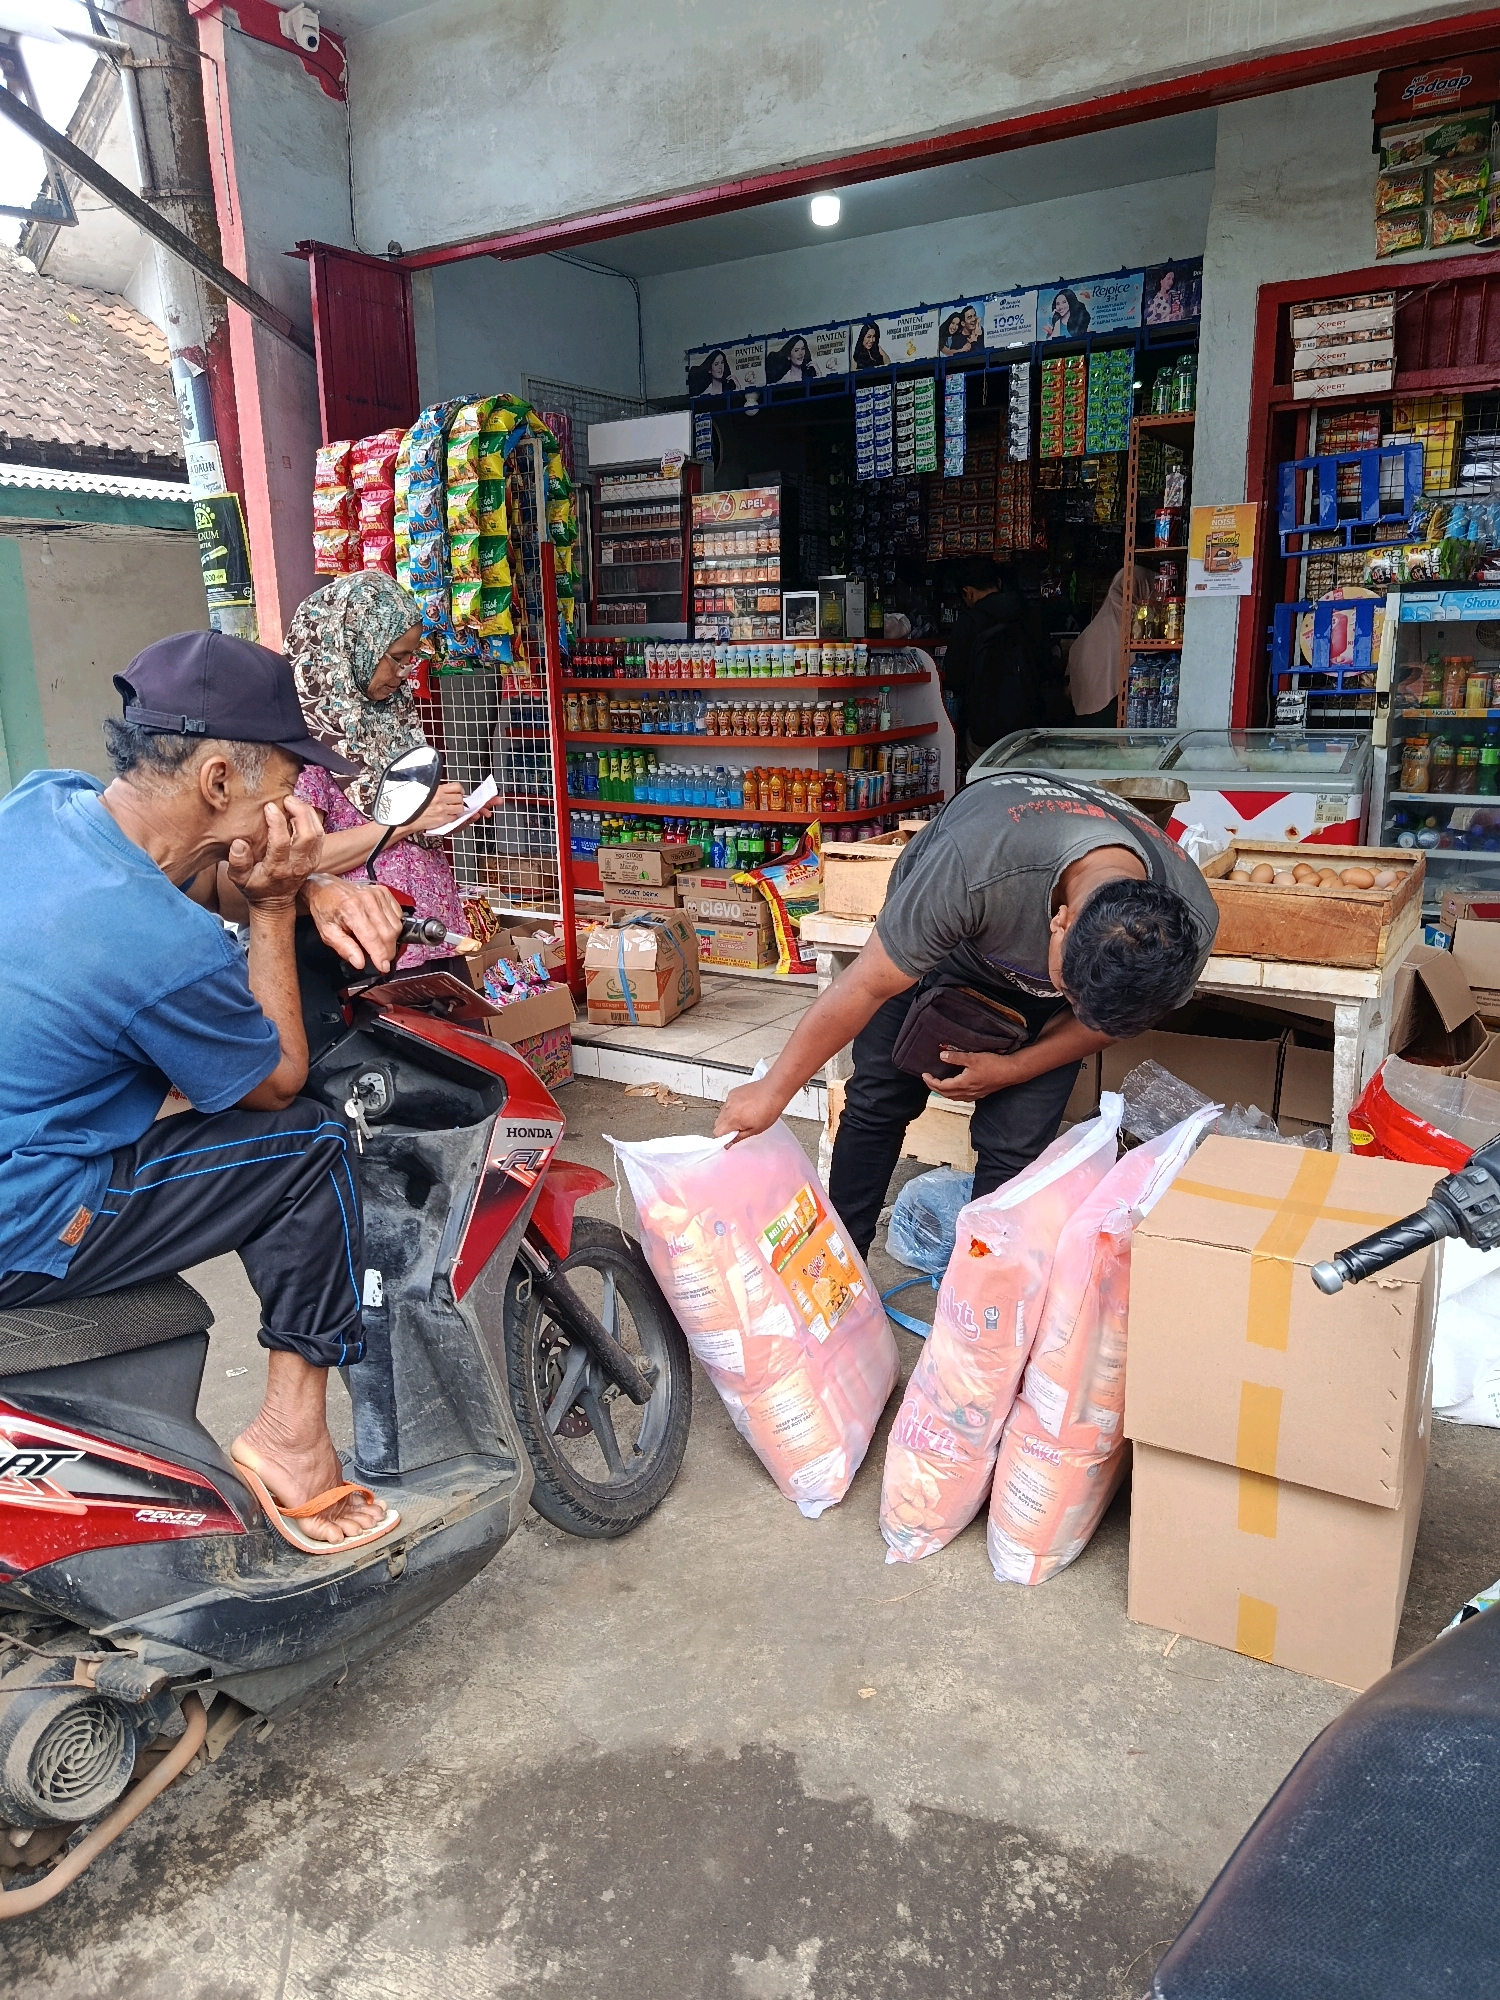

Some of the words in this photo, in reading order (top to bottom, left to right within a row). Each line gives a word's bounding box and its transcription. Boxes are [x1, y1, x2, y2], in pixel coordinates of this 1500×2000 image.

[1402, 74, 1472, 99] Sedaap
[1092, 283, 1131, 297] Rejoice
[897, 316, 924, 326] PANTENE
[993, 313, 1024, 328] 100%
[816, 331, 846, 342] PANTENE
[735, 345, 763, 357] PANTENE
[739, 499, 765, 510] APEL
[1465, 596, 1499, 609] Show
[618, 888, 640, 896] YOGURT
[506, 1127, 553, 1139] HONDA
[500, 1149, 544, 1170] FI
[768, 1226, 779, 1240] BELI
